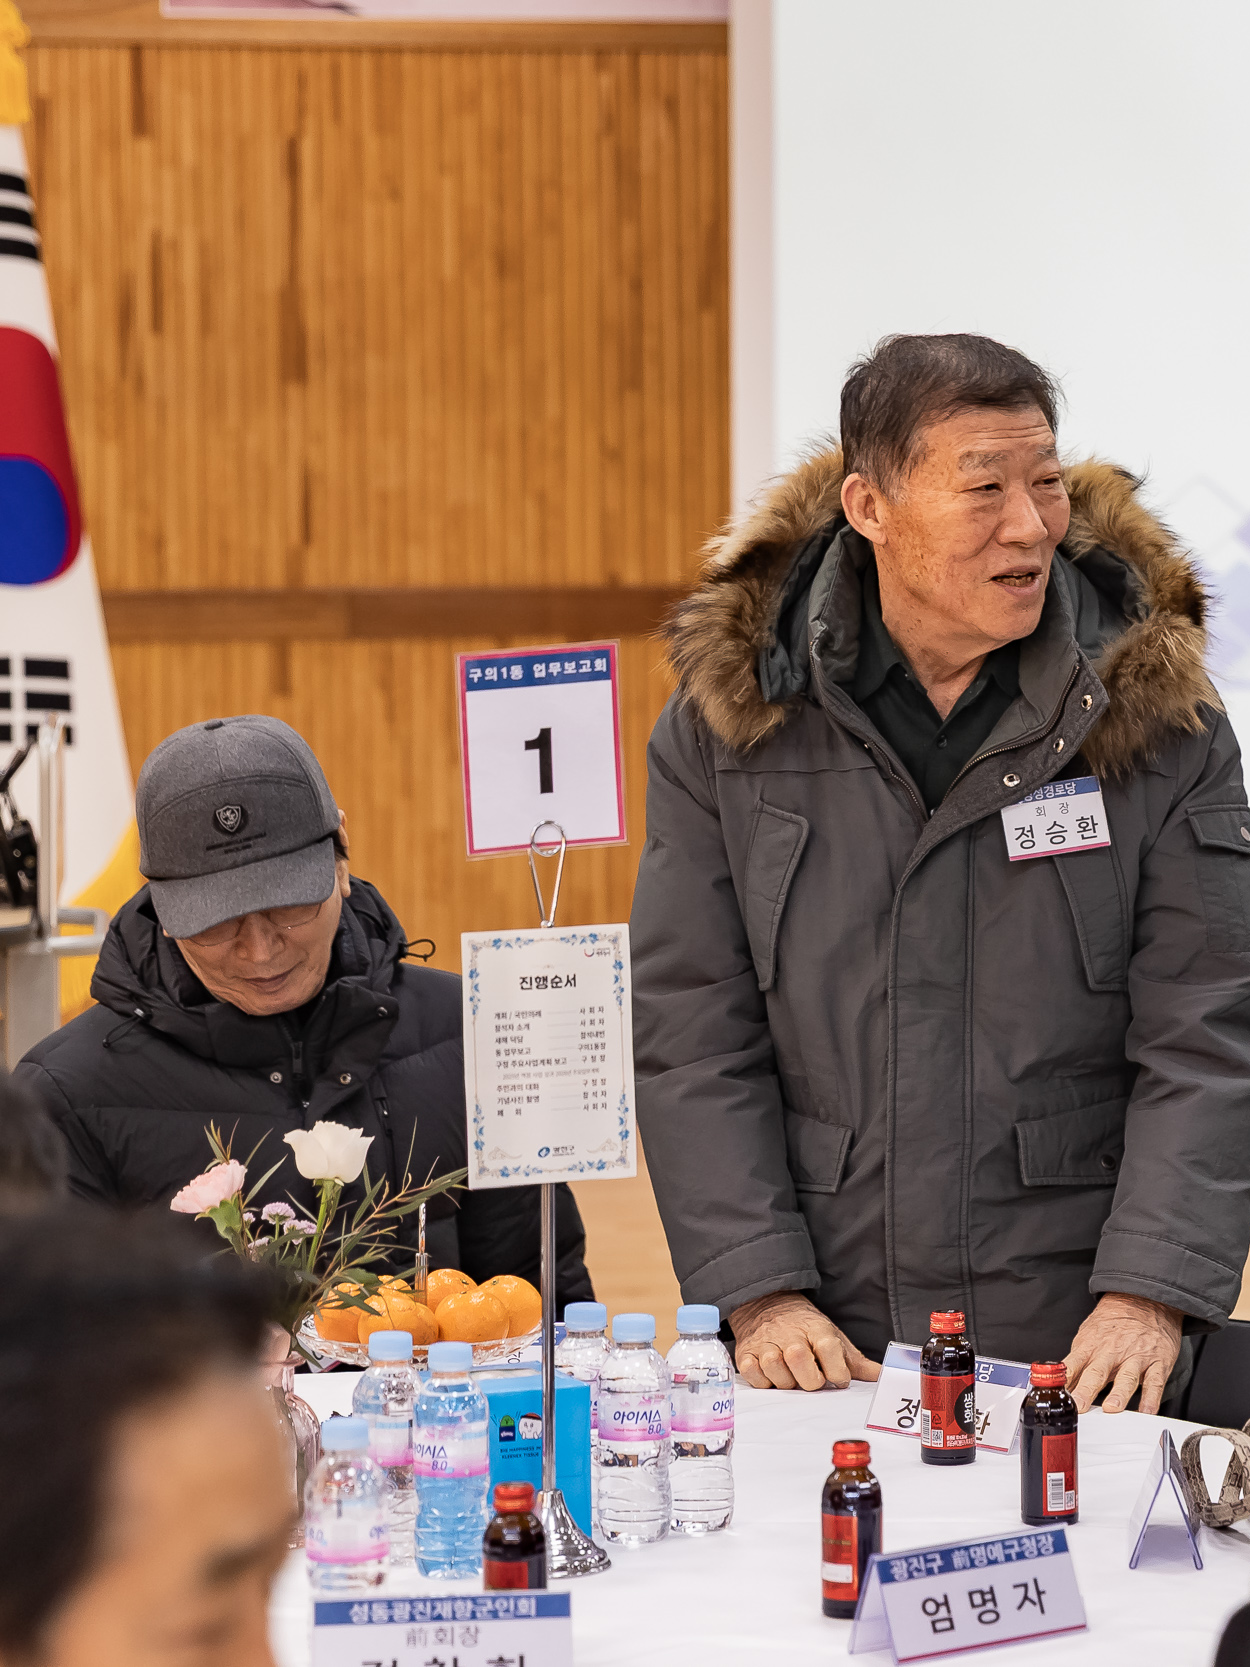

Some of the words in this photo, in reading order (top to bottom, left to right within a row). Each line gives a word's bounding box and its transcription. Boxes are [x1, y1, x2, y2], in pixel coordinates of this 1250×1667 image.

[468, 664, 524, 683] 구의1동
[533, 657, 608, 678] 업무보고회
[524, 727, 554, 794] 1
[1018, 781, 1077, 804] 성경로당
[519, 973, 577, 991] 진행순서
[503, 1047, 531, 1057] 업무보고
[613, 1409, 662, 1425] 아이시스
[648, 1423, 662, 1435] 8.0
[415, 1443, 448, 1460] 이시스
[431, 1459, 448, 1472] 8.0
[890, 1552, 945, 1582] 광진구
